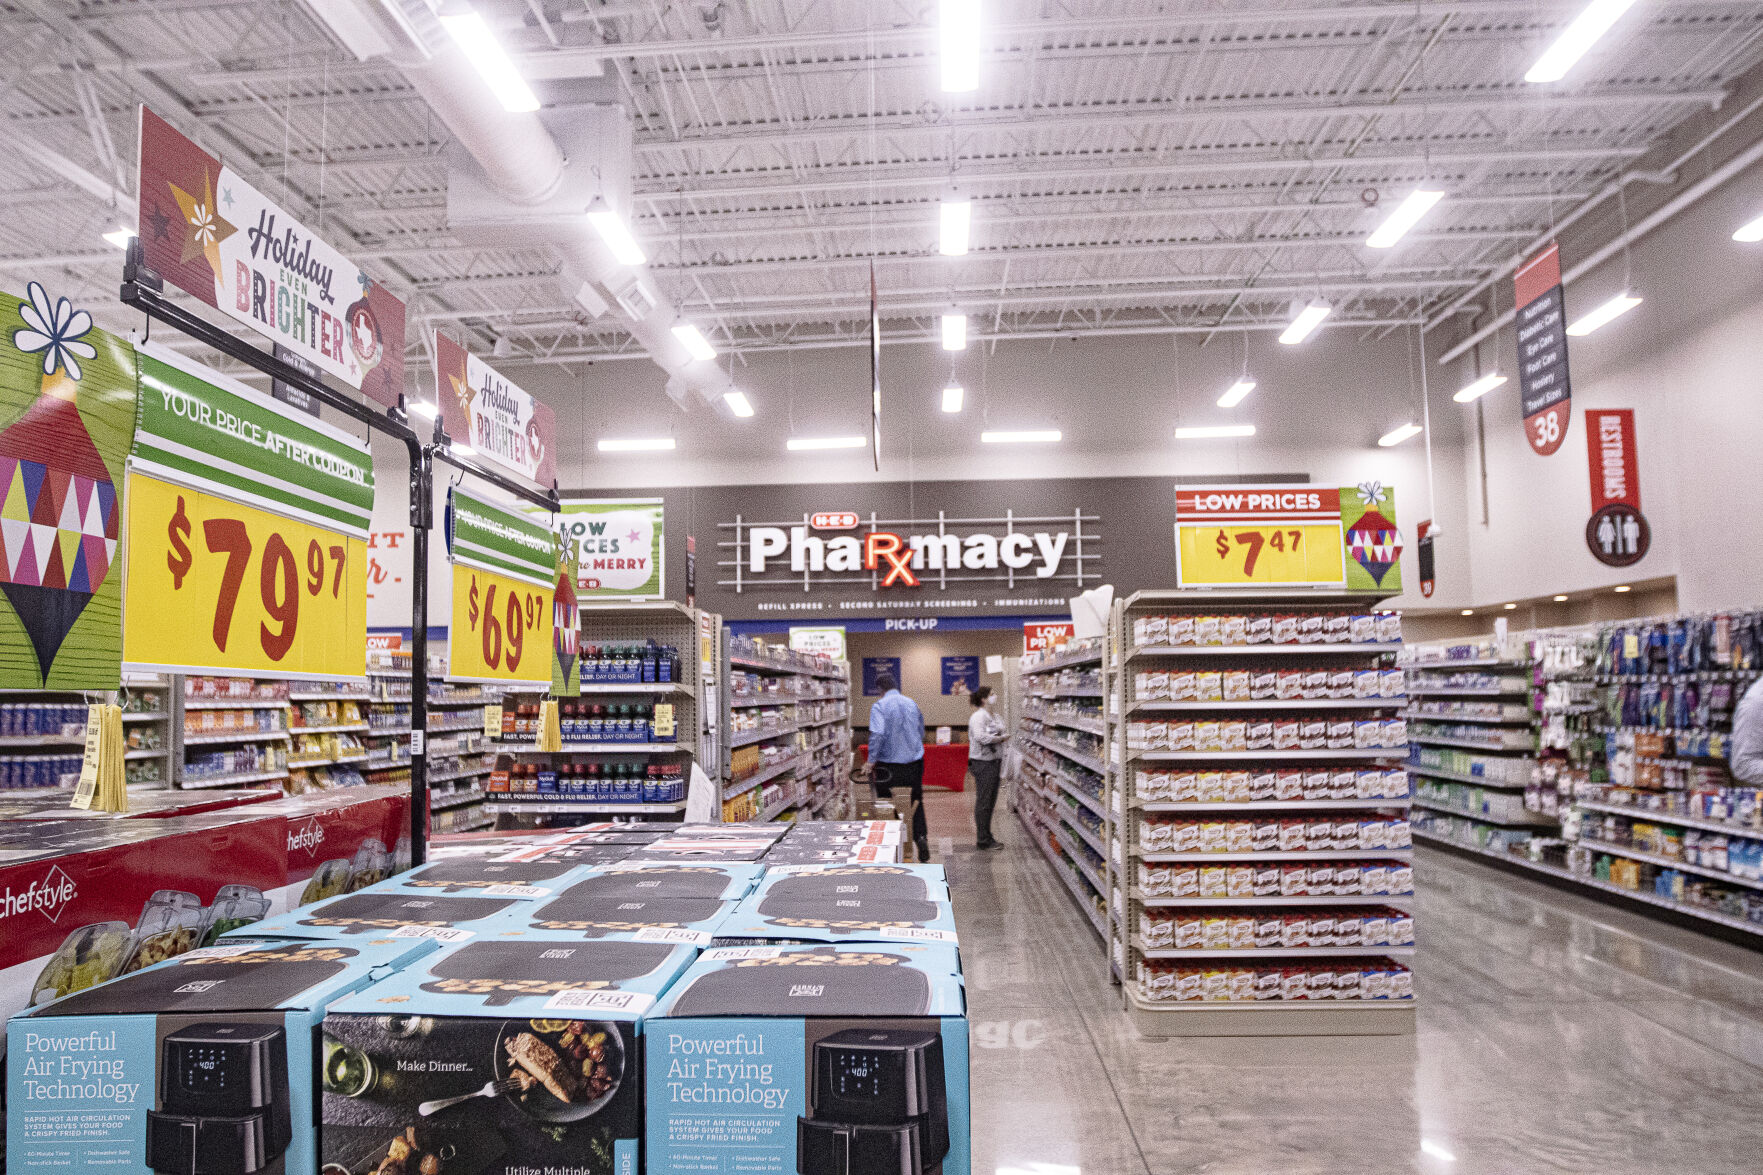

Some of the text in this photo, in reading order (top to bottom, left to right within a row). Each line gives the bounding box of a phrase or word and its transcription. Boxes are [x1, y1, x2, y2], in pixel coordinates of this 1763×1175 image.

[248, 209, 335, 305] Holiday
[279, 269, 308, 296] EVEN
[236, 258, 344, 365] BRIGHTER
[1543, 352, 1557, 365] Care
[480, 373, 520, 426] Holiday
[160, 391, 364, 483] YOUR PRICE AFTER COUPON
[477, 412, 527, 466] BRIGHTER
[1535, 411, 1560, 447] 38
[1600, 415, 1627, 499] RESTROOMS
[1194, 493, 1320, 511] LOW PRICES
[583, 538, 620, 554] CES
[593, 557, 647, 570] MERRY
[840, 601, 874, 609] SECOND
[923, 600, 978, 608] SCREENINGS
[994, 598, 1065, 606] IMMUNIZATIONS
[885, 618, 938, 631] PICK-UP
[1036, 626, 1067, 638] LOW
[365, 638, 389, 649] OW
[287, 825, 323, 851] hefstyle
[25, 1031, 116, 1052] Powerful
[668, 1034, 764, 1055] Powerful
[23, 1056, 125, 1080] Air Frying
[397, 1060, 426, 1072] Make
[667, 1059, 773, 1083] Air Frying
[23, 1079, 140, 1103] Technology
[667, 1082, 790, 1109] Technology
[80, 1114, 131, 1122] CIRCULATION
